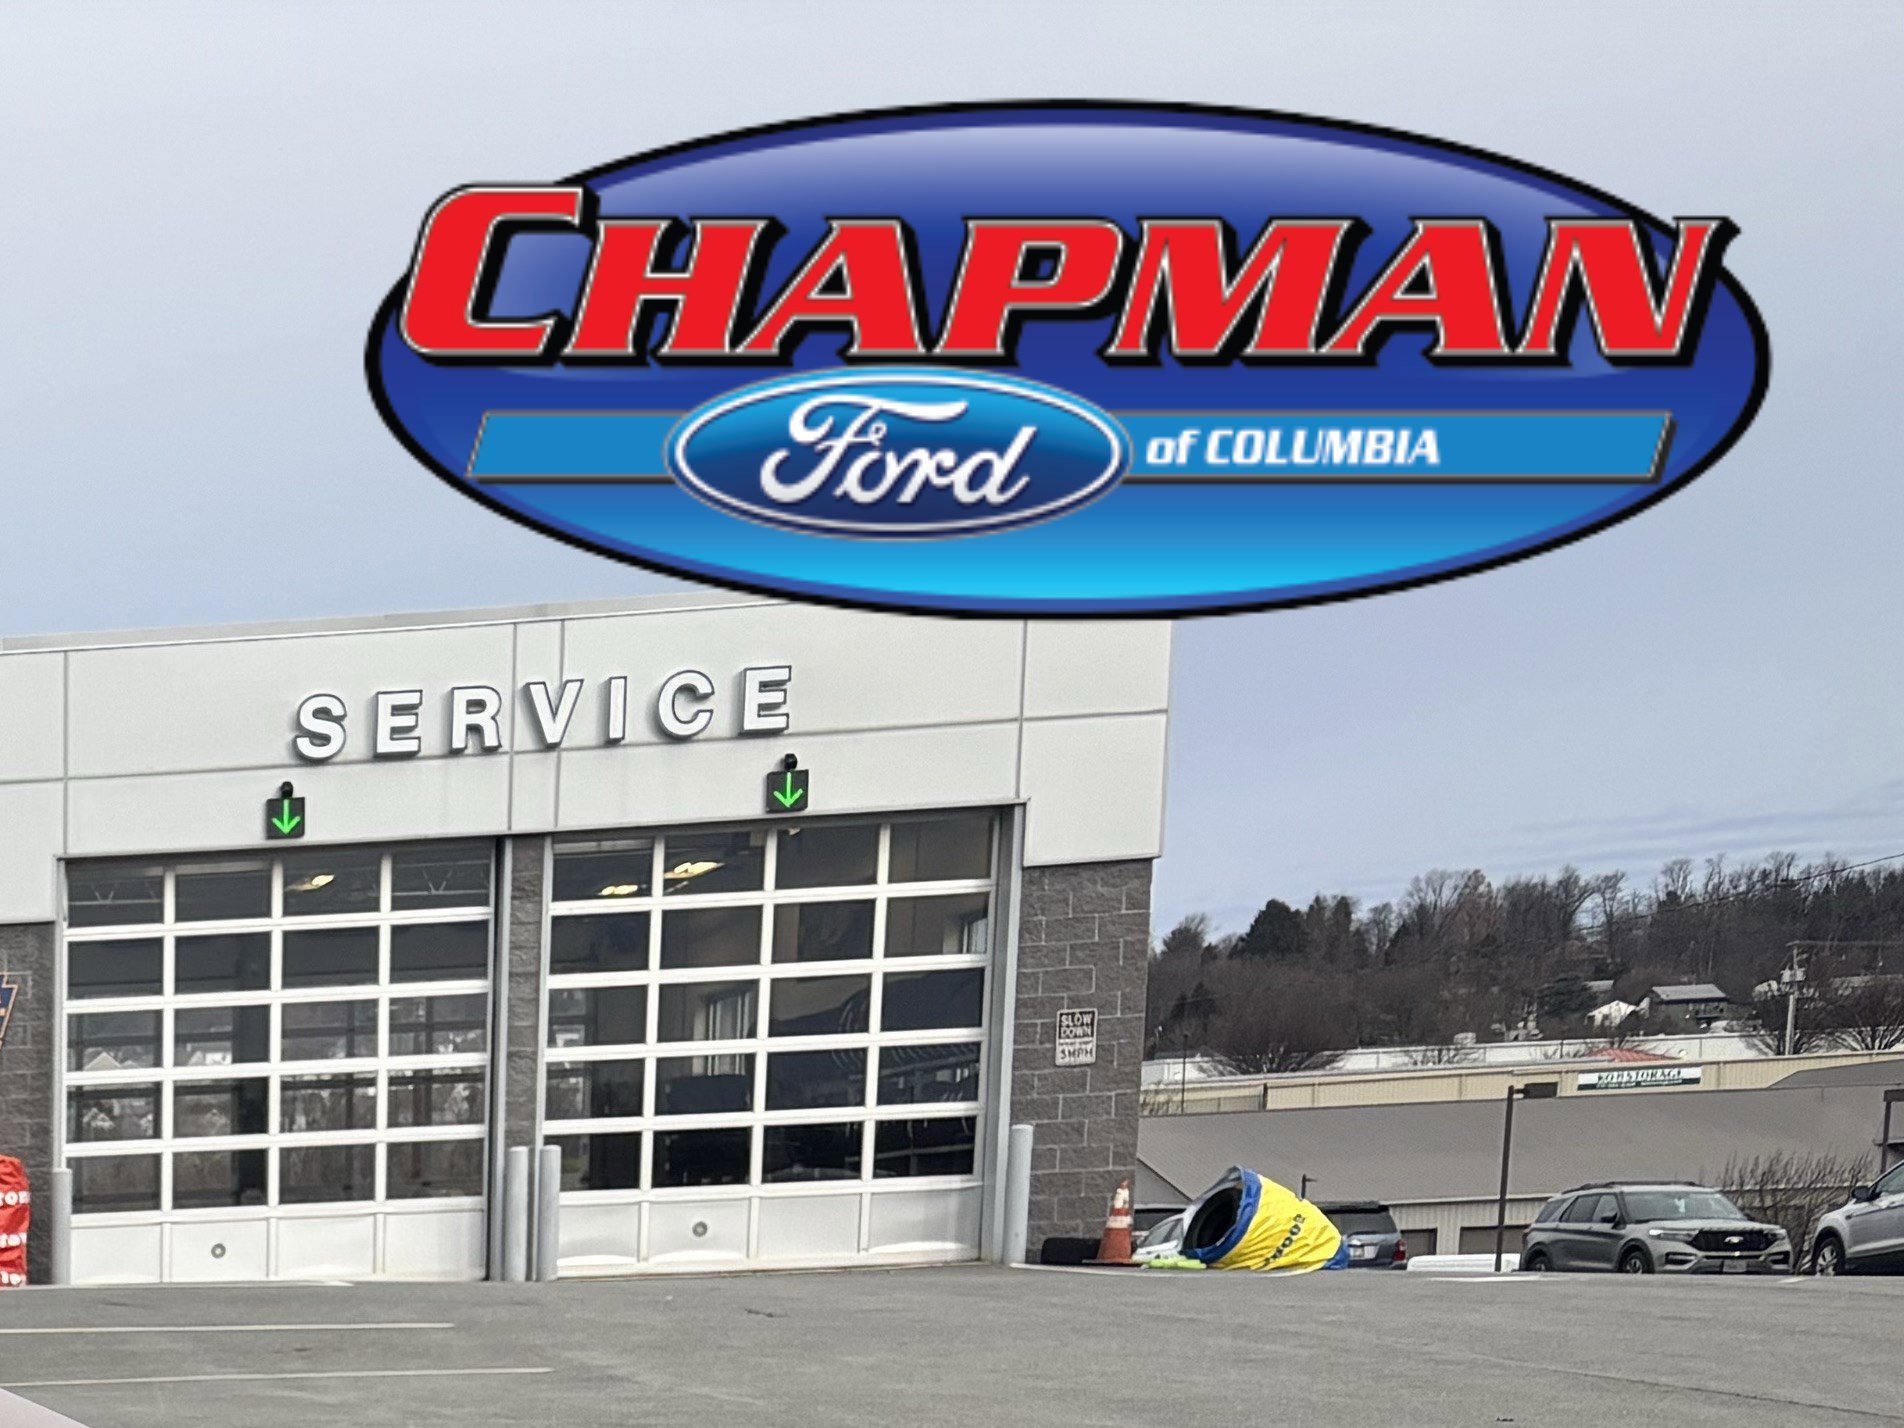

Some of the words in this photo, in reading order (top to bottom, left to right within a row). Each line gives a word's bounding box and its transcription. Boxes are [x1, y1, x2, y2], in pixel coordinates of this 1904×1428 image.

[294, 664, 793, 761] SERVICE
[1060, 1012, 1093, 1026] SLOW
[1060, 1026, 1092, 1038] DOWN
